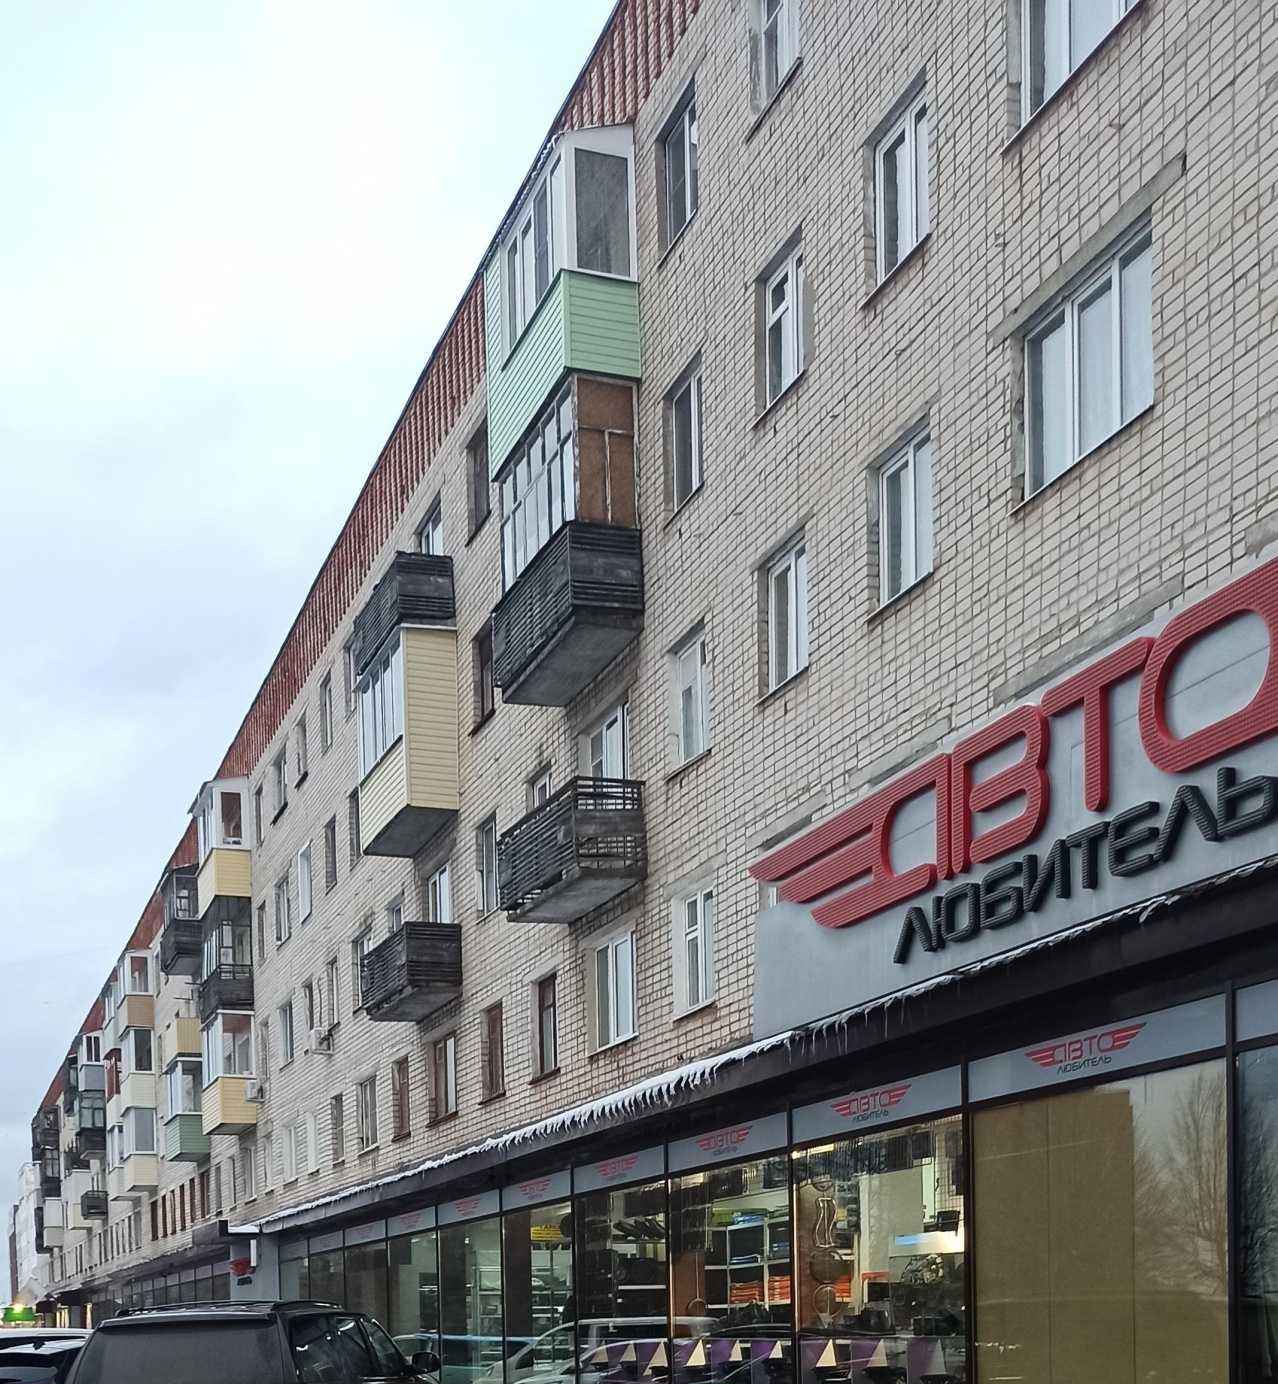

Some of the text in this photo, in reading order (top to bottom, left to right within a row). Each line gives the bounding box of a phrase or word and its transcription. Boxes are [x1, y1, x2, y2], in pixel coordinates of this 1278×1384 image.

[872, 557, 1278, 881] АВТО
[893, 766, 1278, 963] ЛЮБИТЕЛЬ
[1057, 1055, 1112, 1075] ЛЮБИТЕЛЬ
